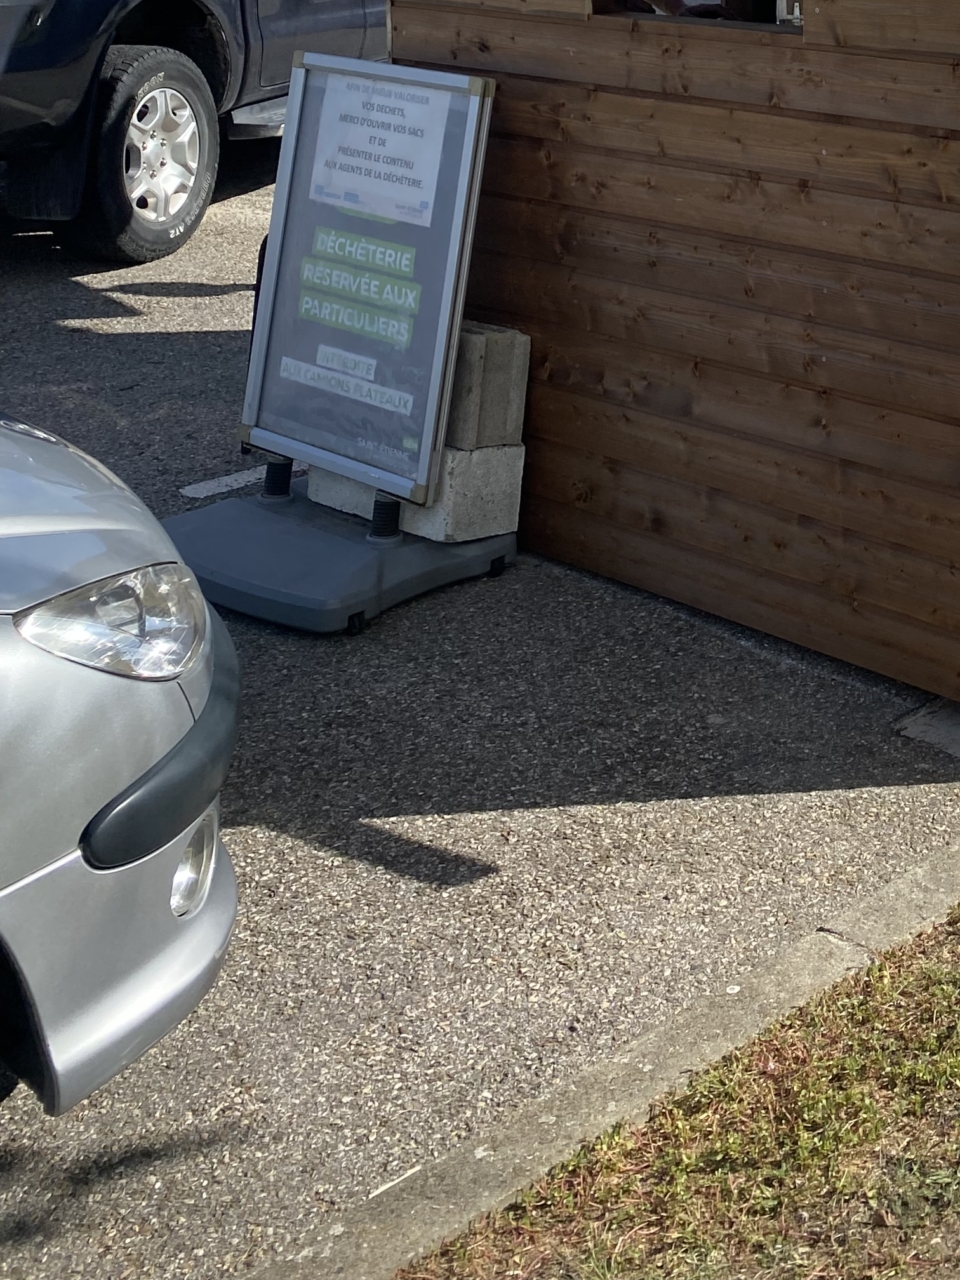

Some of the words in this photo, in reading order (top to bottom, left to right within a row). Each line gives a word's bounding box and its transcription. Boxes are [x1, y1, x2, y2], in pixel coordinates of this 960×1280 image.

[345, 81, 360, 92] AFIN
[361, 84, 371, 94] DE
[371, 85, 392, 98] MIEUX
[394, 90, 430, 105] VALORISER
[362, 100, 375, 111] VOS
[339, 113, 359, 125] MERCI
[360, 117, 392, 132] D'OUVRIR
[393, 123, 407, 134] VOS
[407, 126, 425, 138] SACS
[368, 135, 377, 145] ET
[377, 137, 387, 147] DE
[337, 145, 373, 161] PRÉSENTER
[373, 153, 381, 163] LE
[382, 155, 414, 170] CONTENU
[324, 159, 337, 170] AUX
[337, 163, 363, 176] AGENTS
[363, 168, 373, 178] DE
[373, 170, 382, 180] LA
[383, 171, 424, 190] DÉCHÈTERIE.
[316, 230, 411, 272] DÉCHÈTERIE
[303, 261, 380, 299] RÉSERVÉE
[382, 283, 417, 309] AUX
[301, 296, 409, 343] PARTICULIERS
[320, 351, 373, 376] INTERDITE
[282, 362, 303, 377] AUX
[303, 368, 351, 393] CAMIONS
[353, 383, 410, 412] PLATEAUX
